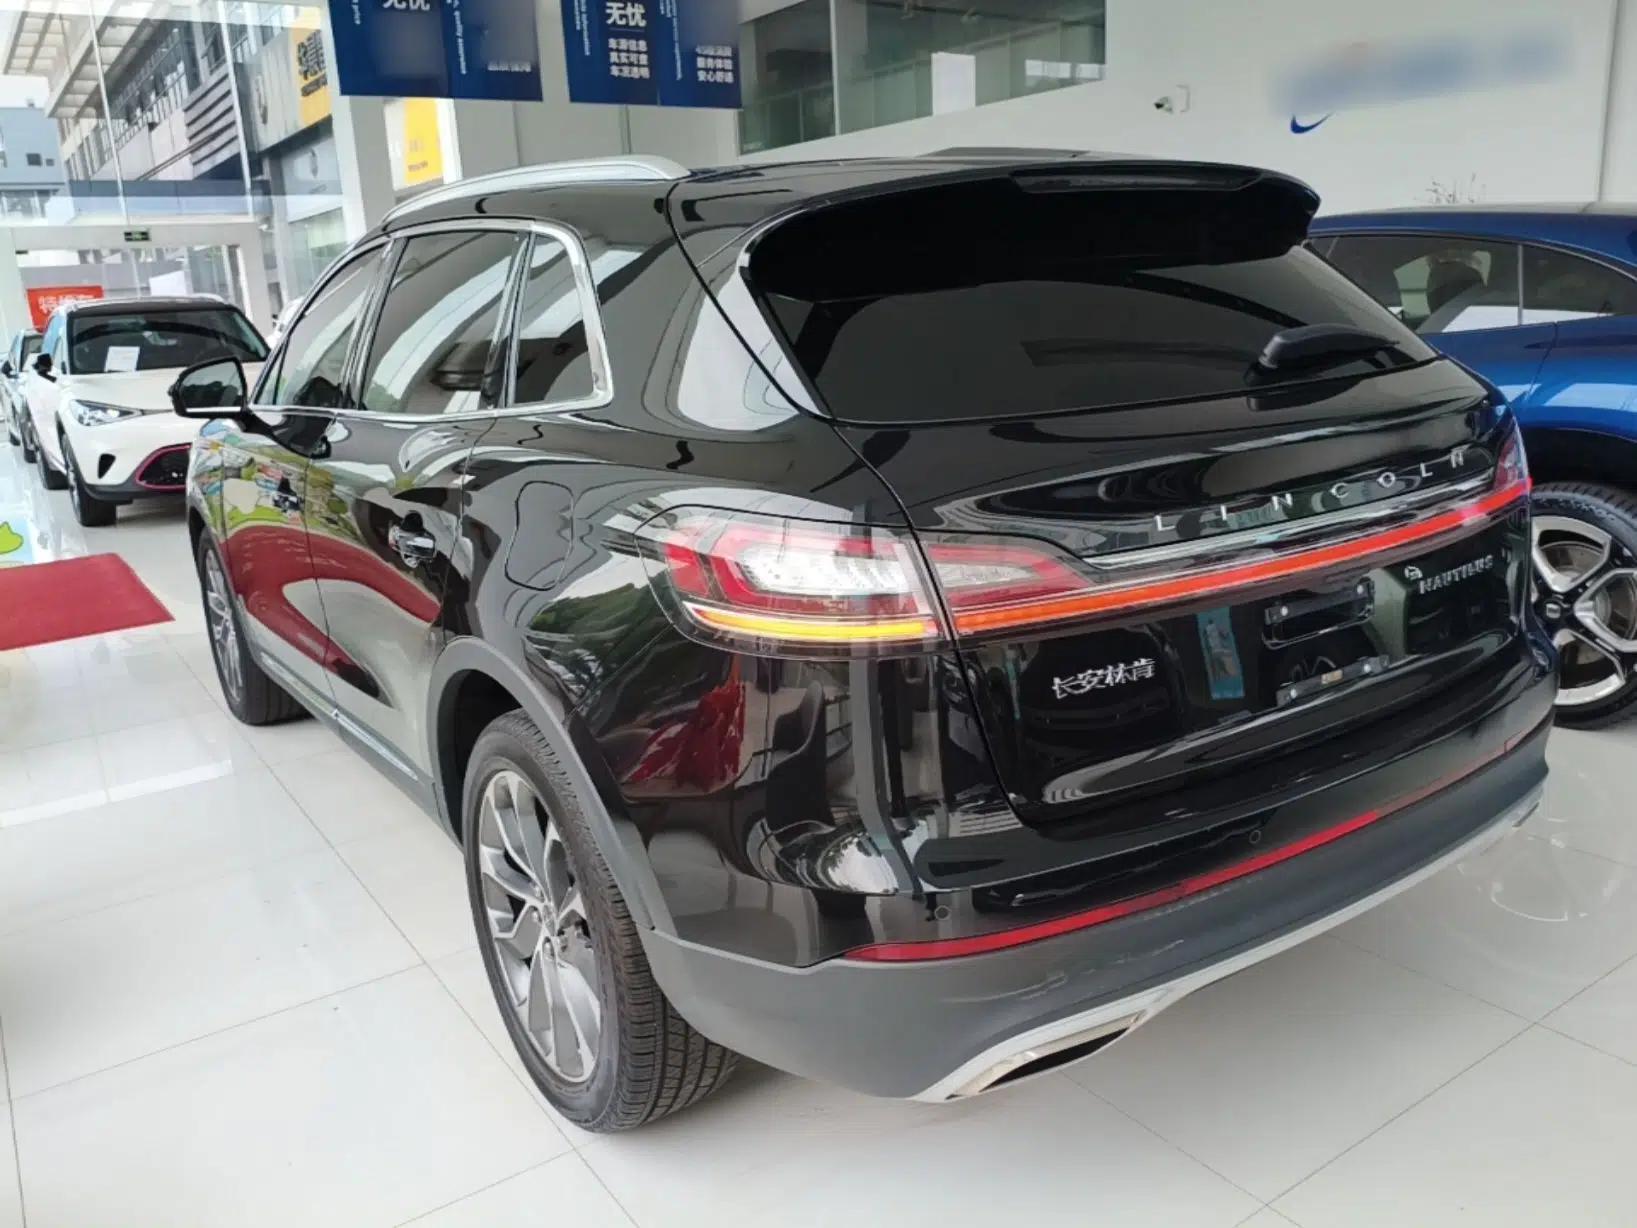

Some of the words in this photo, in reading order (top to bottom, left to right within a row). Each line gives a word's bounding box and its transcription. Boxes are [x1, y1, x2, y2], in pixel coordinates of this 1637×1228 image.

[605, 2, 647, 27] 无忧
[1155, 448, 1465, 531] LINCOLN
[1419, 554, 1494, 594] NAUTILUS
[1052, 658, 1156, 699] 长安林肯
